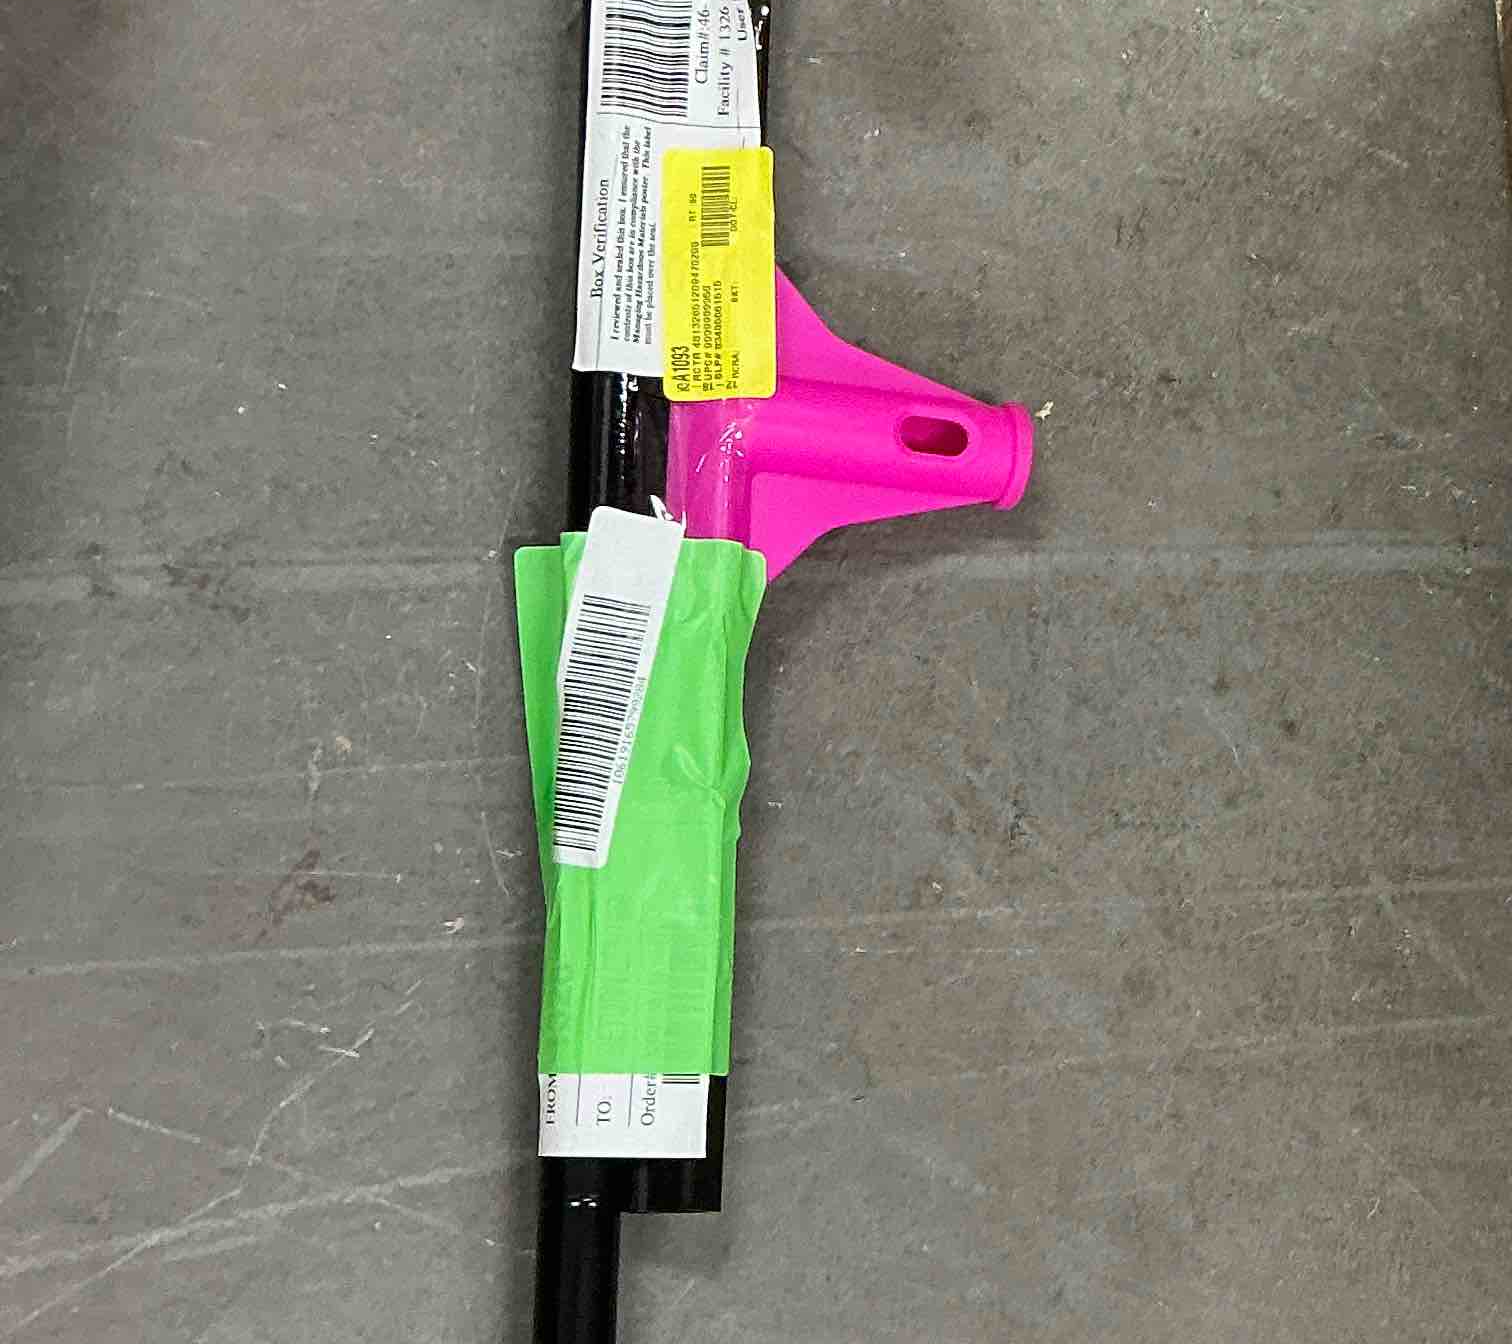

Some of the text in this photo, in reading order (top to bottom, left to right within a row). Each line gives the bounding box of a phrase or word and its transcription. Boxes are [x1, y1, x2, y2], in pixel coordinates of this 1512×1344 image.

[719, 6, 731, 40] 1326
[737, 8, 748, 41] User
[718, 62, 734, 116] Facility
[590, 177, 609, 299] Box Verification
